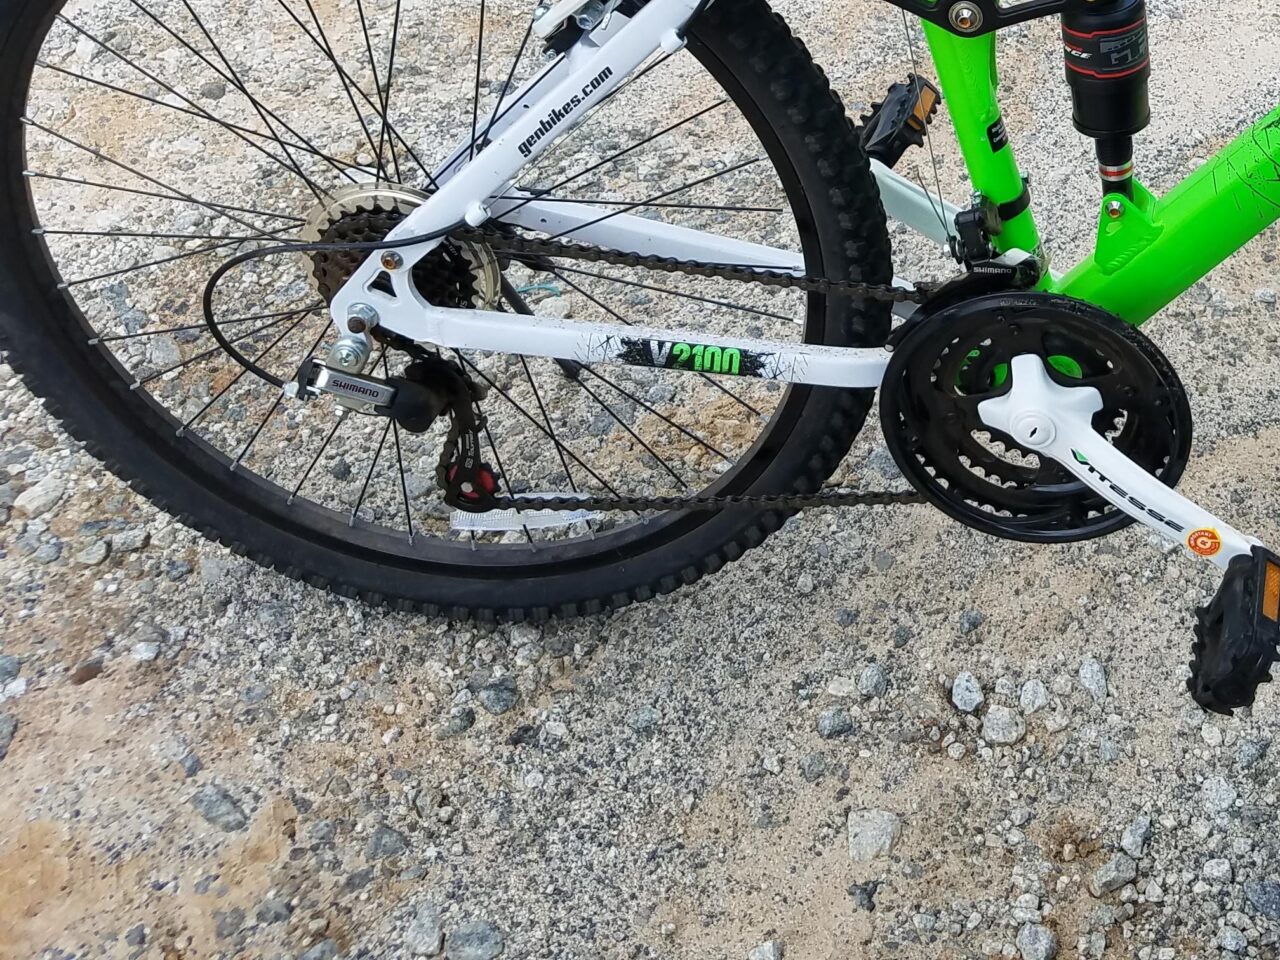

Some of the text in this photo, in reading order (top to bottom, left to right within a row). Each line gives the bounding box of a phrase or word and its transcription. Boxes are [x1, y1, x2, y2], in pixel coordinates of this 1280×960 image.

[517, 66, 614, 158] genbikes.com
[649, 339, 741, 375] V2100
[331, 379, 380, 398] SHIMANO
[1070, 447, 1185, 533] VITESSE
